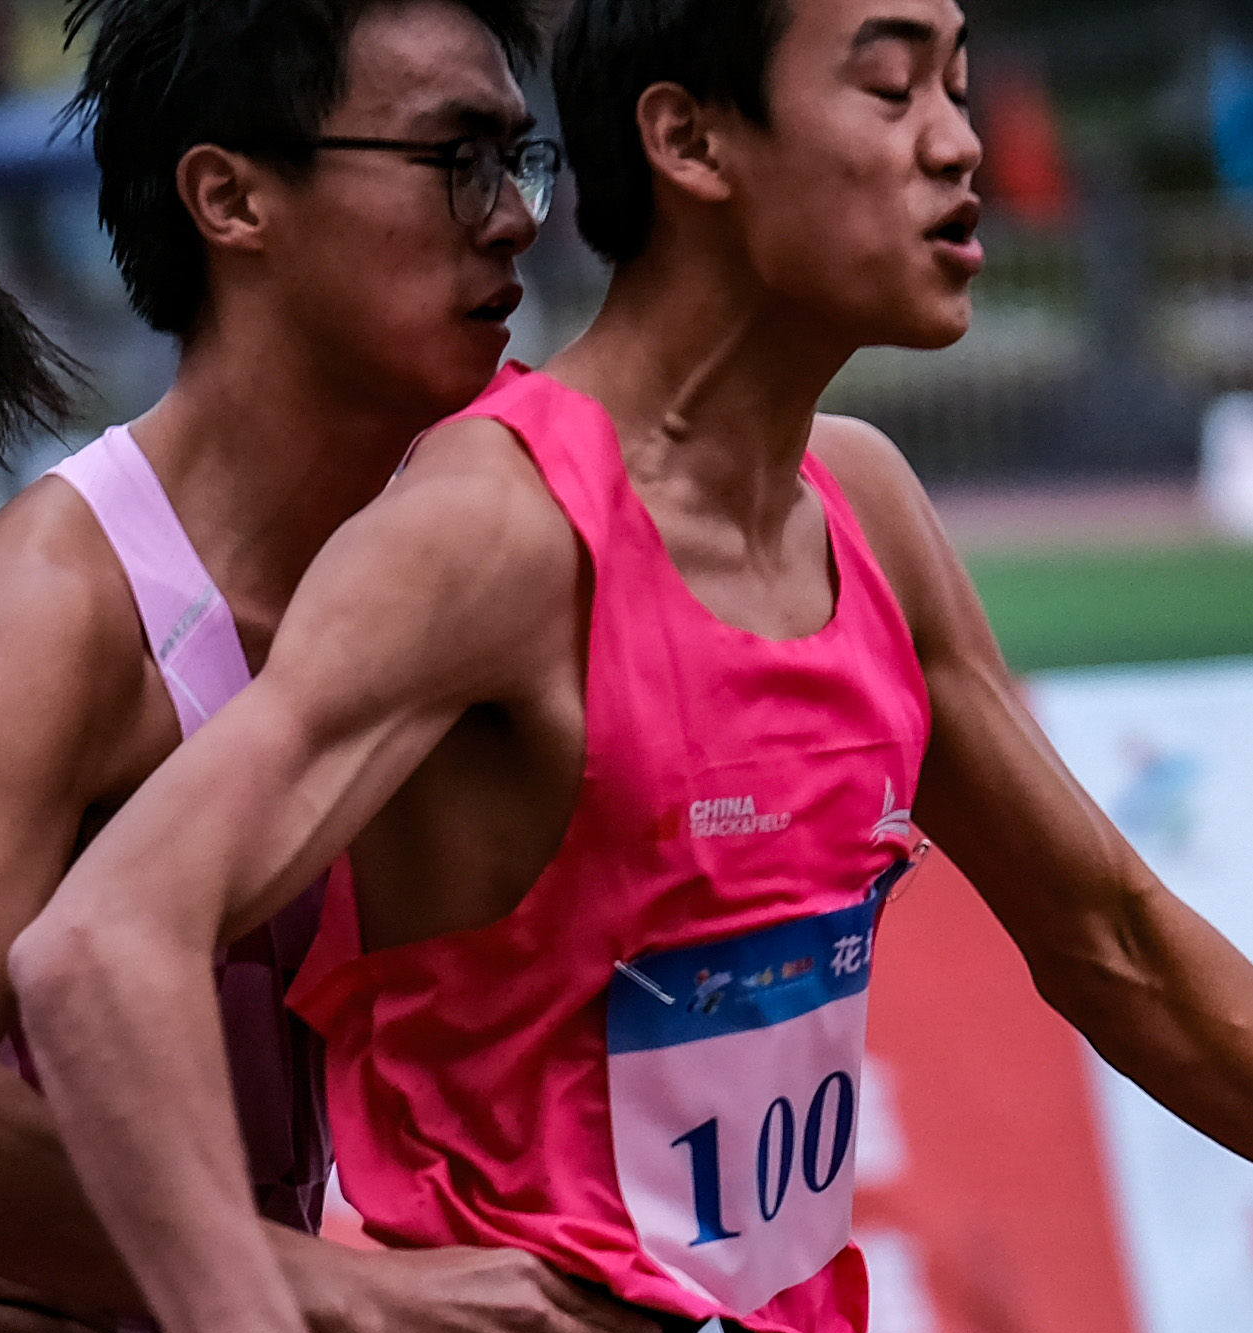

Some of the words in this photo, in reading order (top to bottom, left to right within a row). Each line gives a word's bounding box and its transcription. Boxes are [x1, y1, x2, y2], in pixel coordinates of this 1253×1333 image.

[689, 795, 756, 821] CHINA
[830, 927, 874, 977] 花
[670, 1071, 854, 1247] 100
